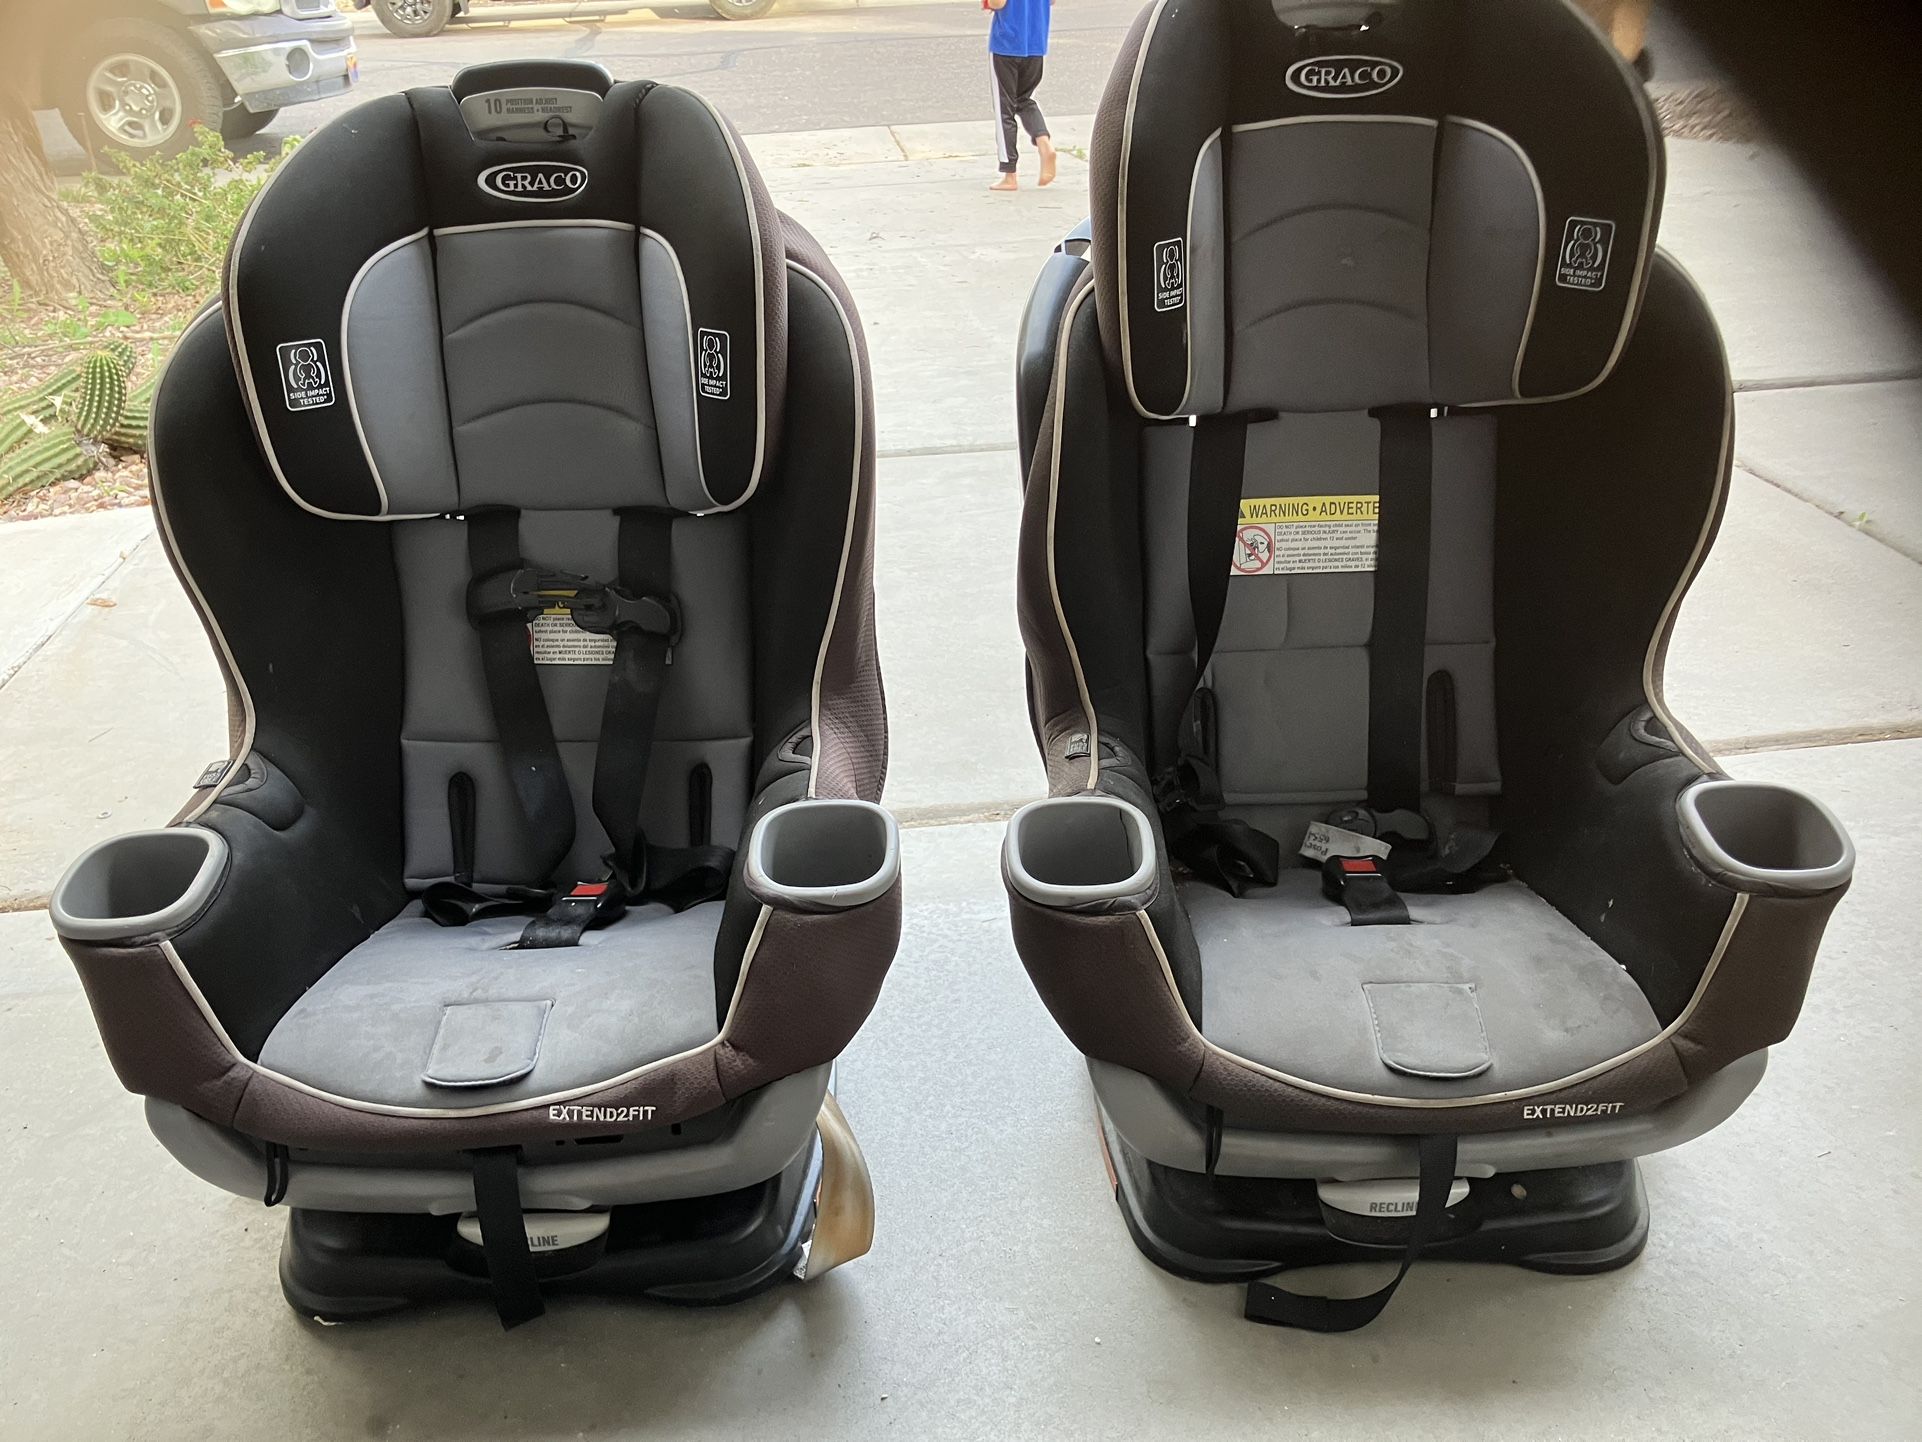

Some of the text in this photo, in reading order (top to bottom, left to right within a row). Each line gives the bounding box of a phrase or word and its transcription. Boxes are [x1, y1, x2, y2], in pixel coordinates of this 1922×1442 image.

[1300, 65, 1392, 87] GRACO
[485, 98, 502, 114] 10
[495, 171, 581, 191] GRACO
[1561, 268, 1602, 278] SIDE IMPACT
[709, 379, 726, 387] IMPACT
[307, 387, 330, 396] IMPACT
[1249, 501, 1379, 519] WARNING ADVERTE
[549, 1105, 656, 1121] EXTEND2FIT
[1523, 1103, 1624, 1119] EXTEND2FIT
